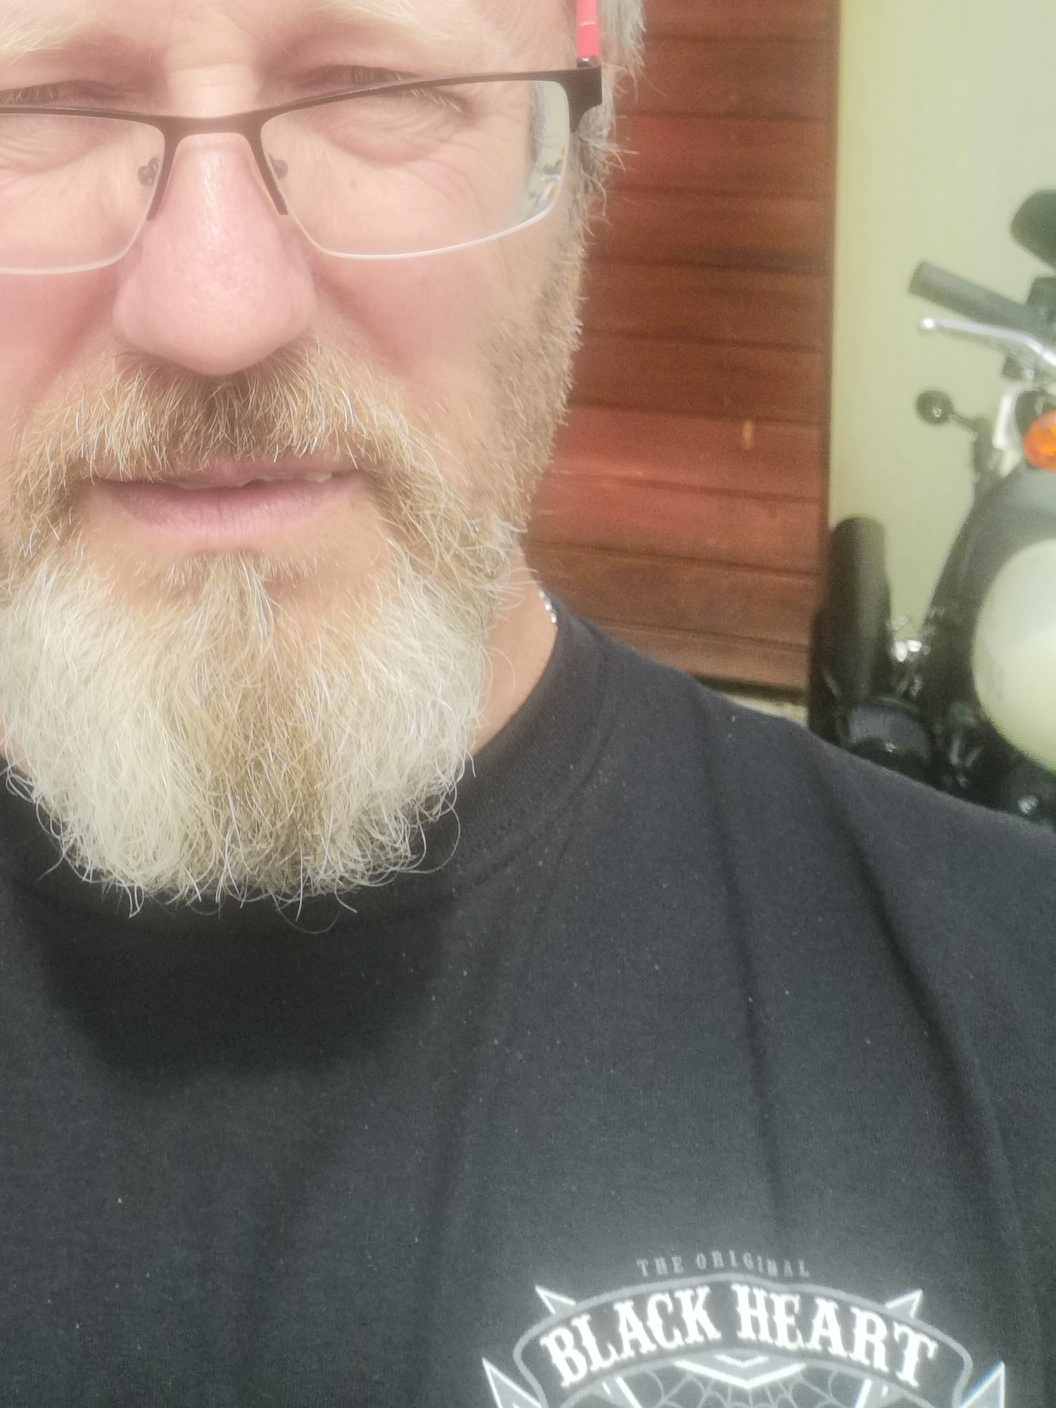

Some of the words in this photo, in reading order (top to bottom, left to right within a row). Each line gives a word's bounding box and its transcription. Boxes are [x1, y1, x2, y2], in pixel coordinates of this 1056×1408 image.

[636, 1255, 684, 1277] THE
[696, 1249, 810, 1278] ORIGINAL
[540, 1286, 721, 1388] BLACK
[731, 1283, 937, 1388] HEART
